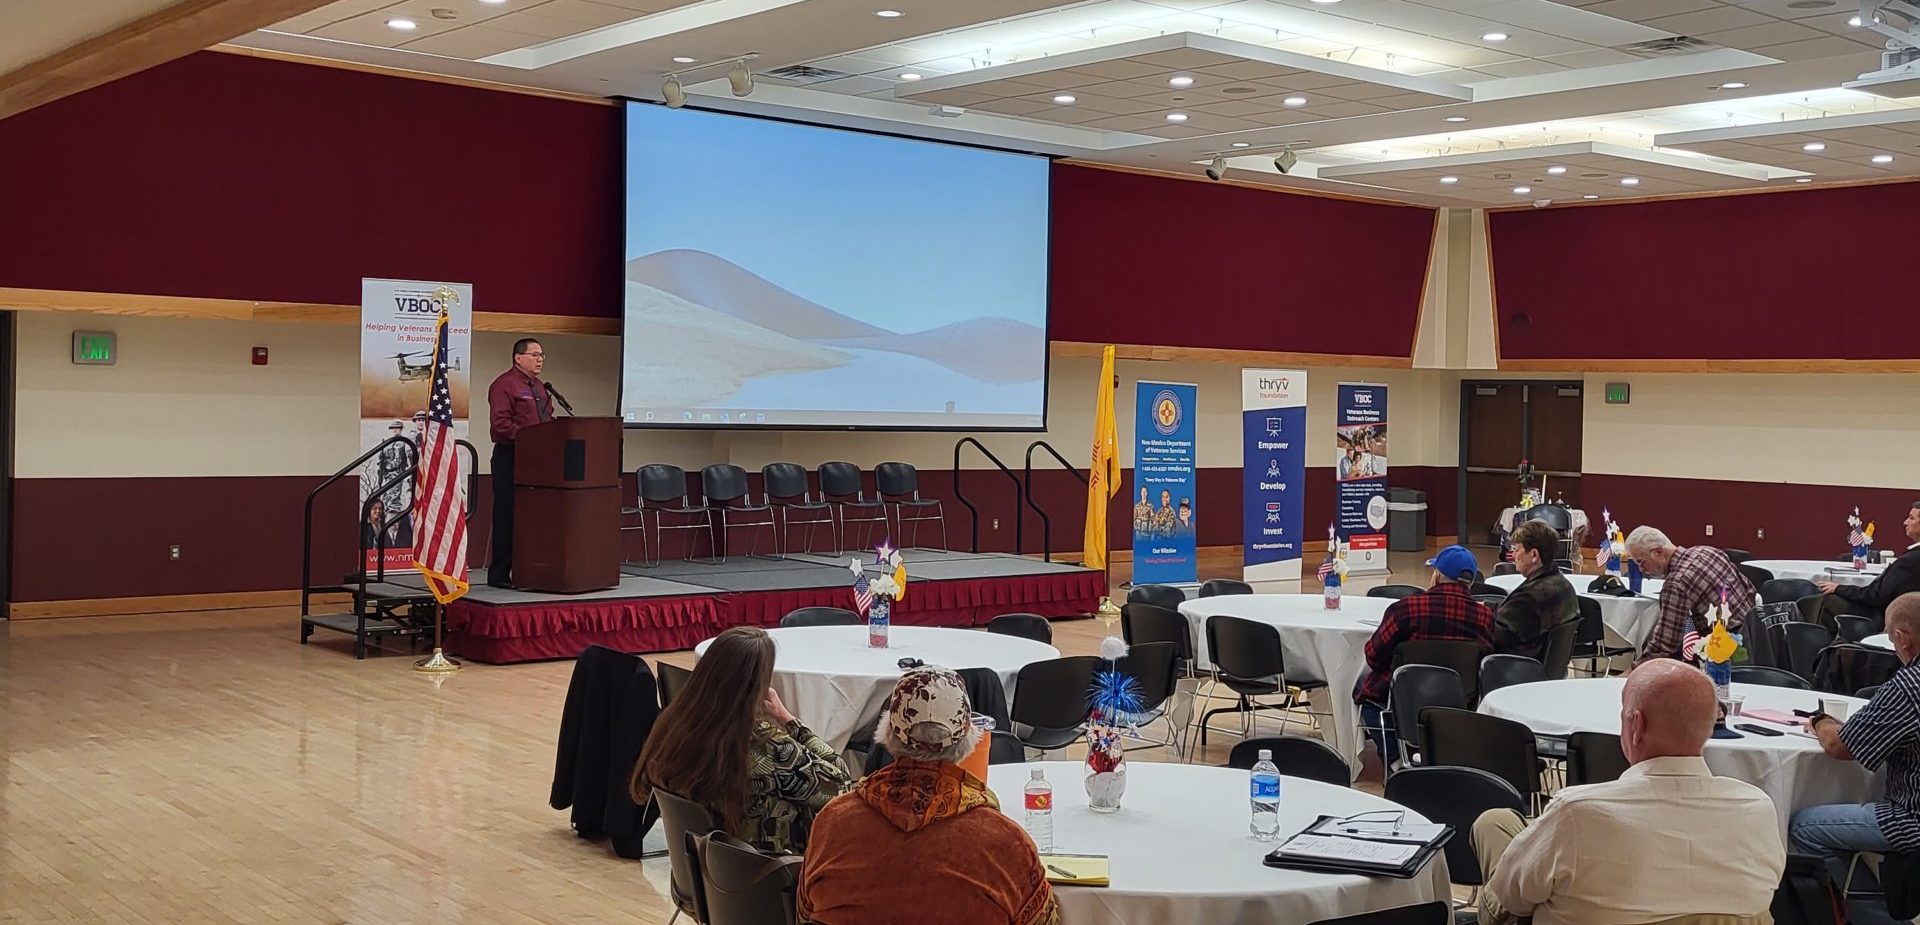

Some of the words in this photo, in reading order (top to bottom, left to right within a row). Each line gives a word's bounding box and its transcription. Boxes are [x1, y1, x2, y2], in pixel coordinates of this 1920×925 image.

[395, 298, 441, 313] VBOC
[366, 323, 396, 332] Helping
[399, 324, 432, 333] Veterans
[434, 325, 468, 335] Sceed
[406, 335, 437, 343] Busines
[80, 336, 111, 360] EXIT
[1259, 377, 1289, 392] thryv
[1354, 394, 1372, 404] VBOC
[1258, 441, 1289, 451] Empower
[1260, 482, 1286, 491] Develop
[1263, 527, 1283, 535] Invest
